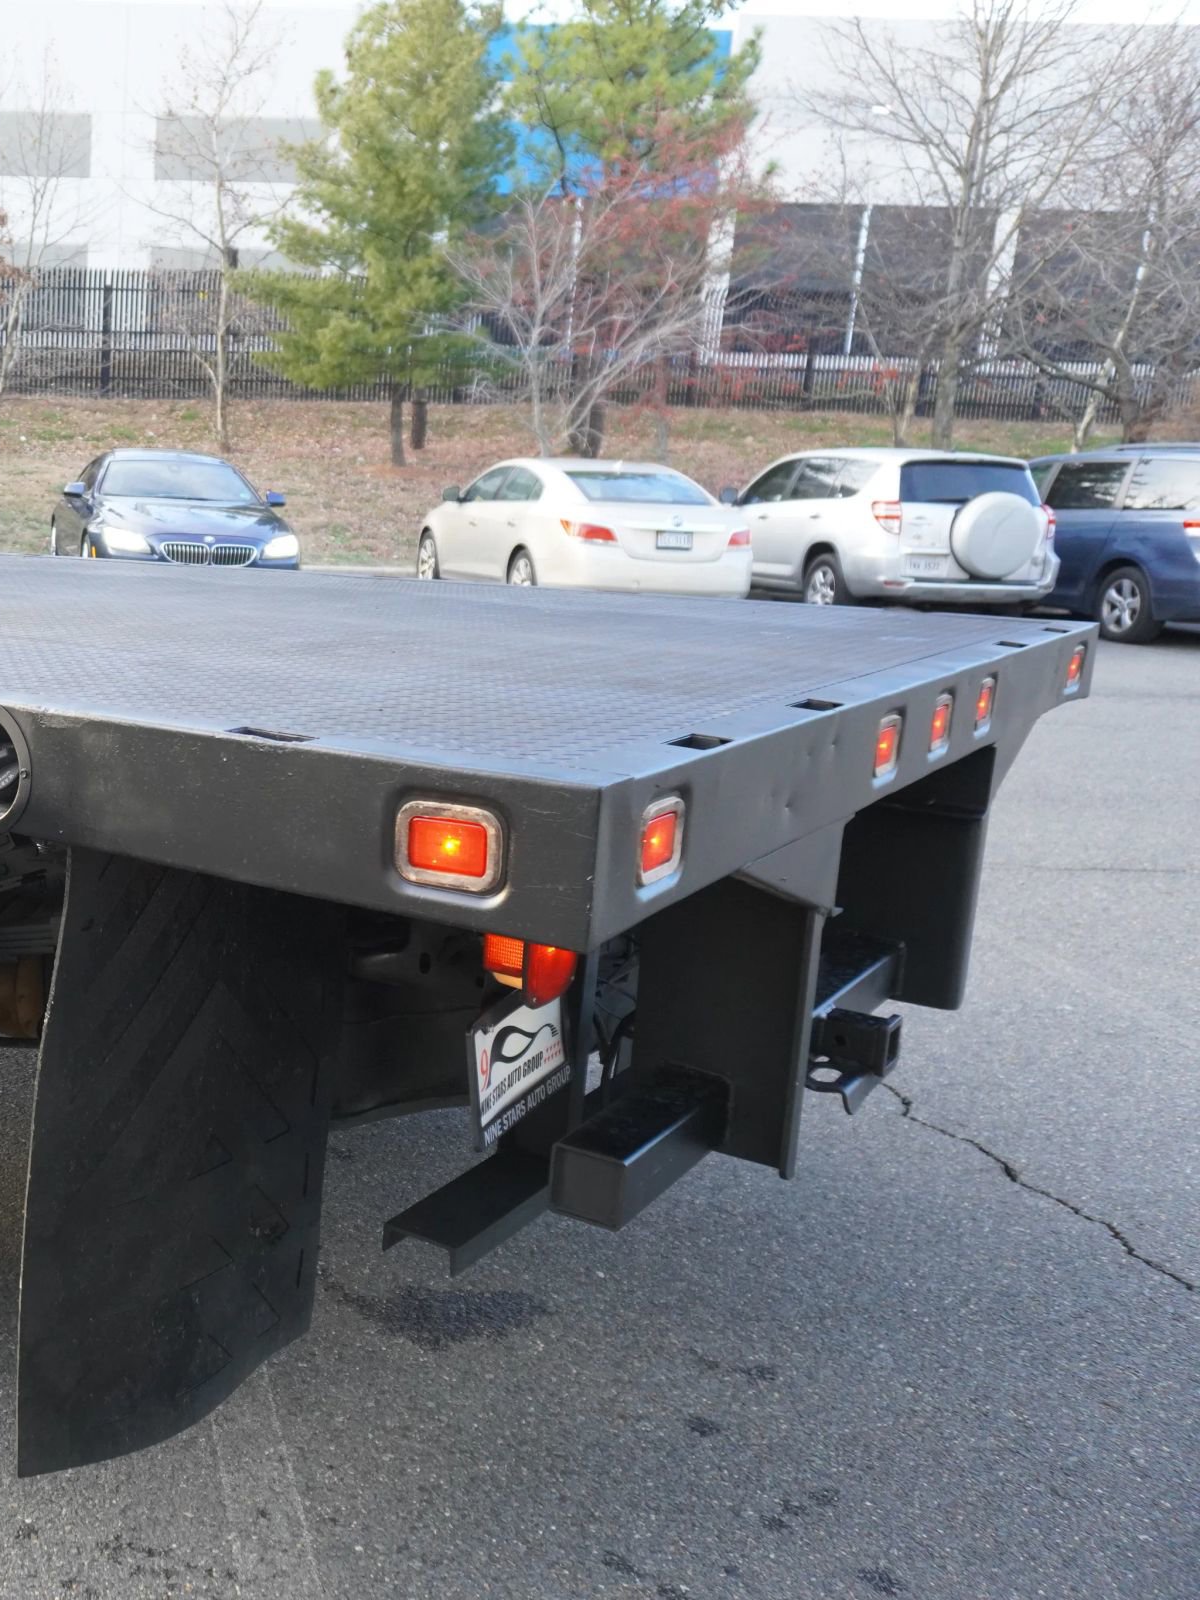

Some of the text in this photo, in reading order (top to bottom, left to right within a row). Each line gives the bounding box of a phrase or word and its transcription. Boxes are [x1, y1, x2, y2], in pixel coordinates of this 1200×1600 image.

[484, 1065, 571, 1147] NINE STARS AUTO GROUP
[492, 1077, 506, 1106] STARS
[507, 1066, 522, 1089] AUTO
[523, 1051, 543, 1078] GROUP
